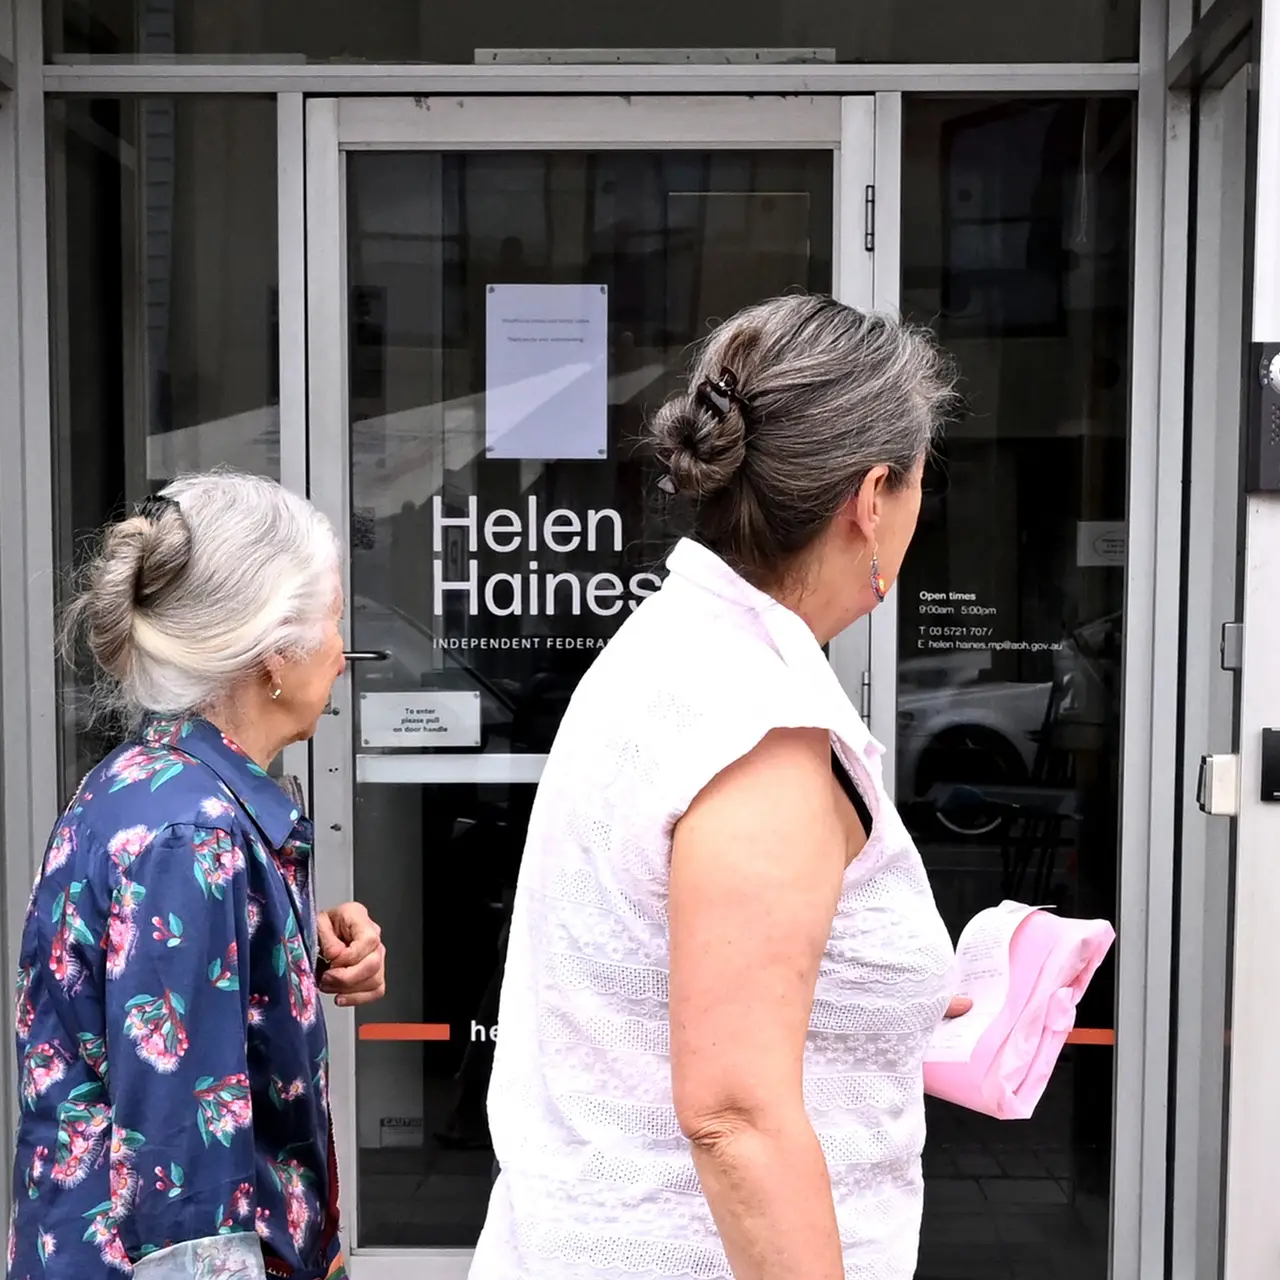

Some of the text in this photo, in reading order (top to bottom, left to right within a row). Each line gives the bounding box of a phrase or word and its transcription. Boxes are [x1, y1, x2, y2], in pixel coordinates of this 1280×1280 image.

[433, 495, 622, 553] Helen
[433, 560, 662, 616] Haines
[919, 591, 976, 601] Open times
[960, 605, 997, 616] 5:00pm
[919, 626, 926, 635] T
[929, 626, 941, 636] 03
[943, 627, 966, 636] 5721
[433, 638, 610, 649] INDEPENDENT FEDERA
[917, 639, 924, 649] E
[401, 717, 440, 725] please pull
